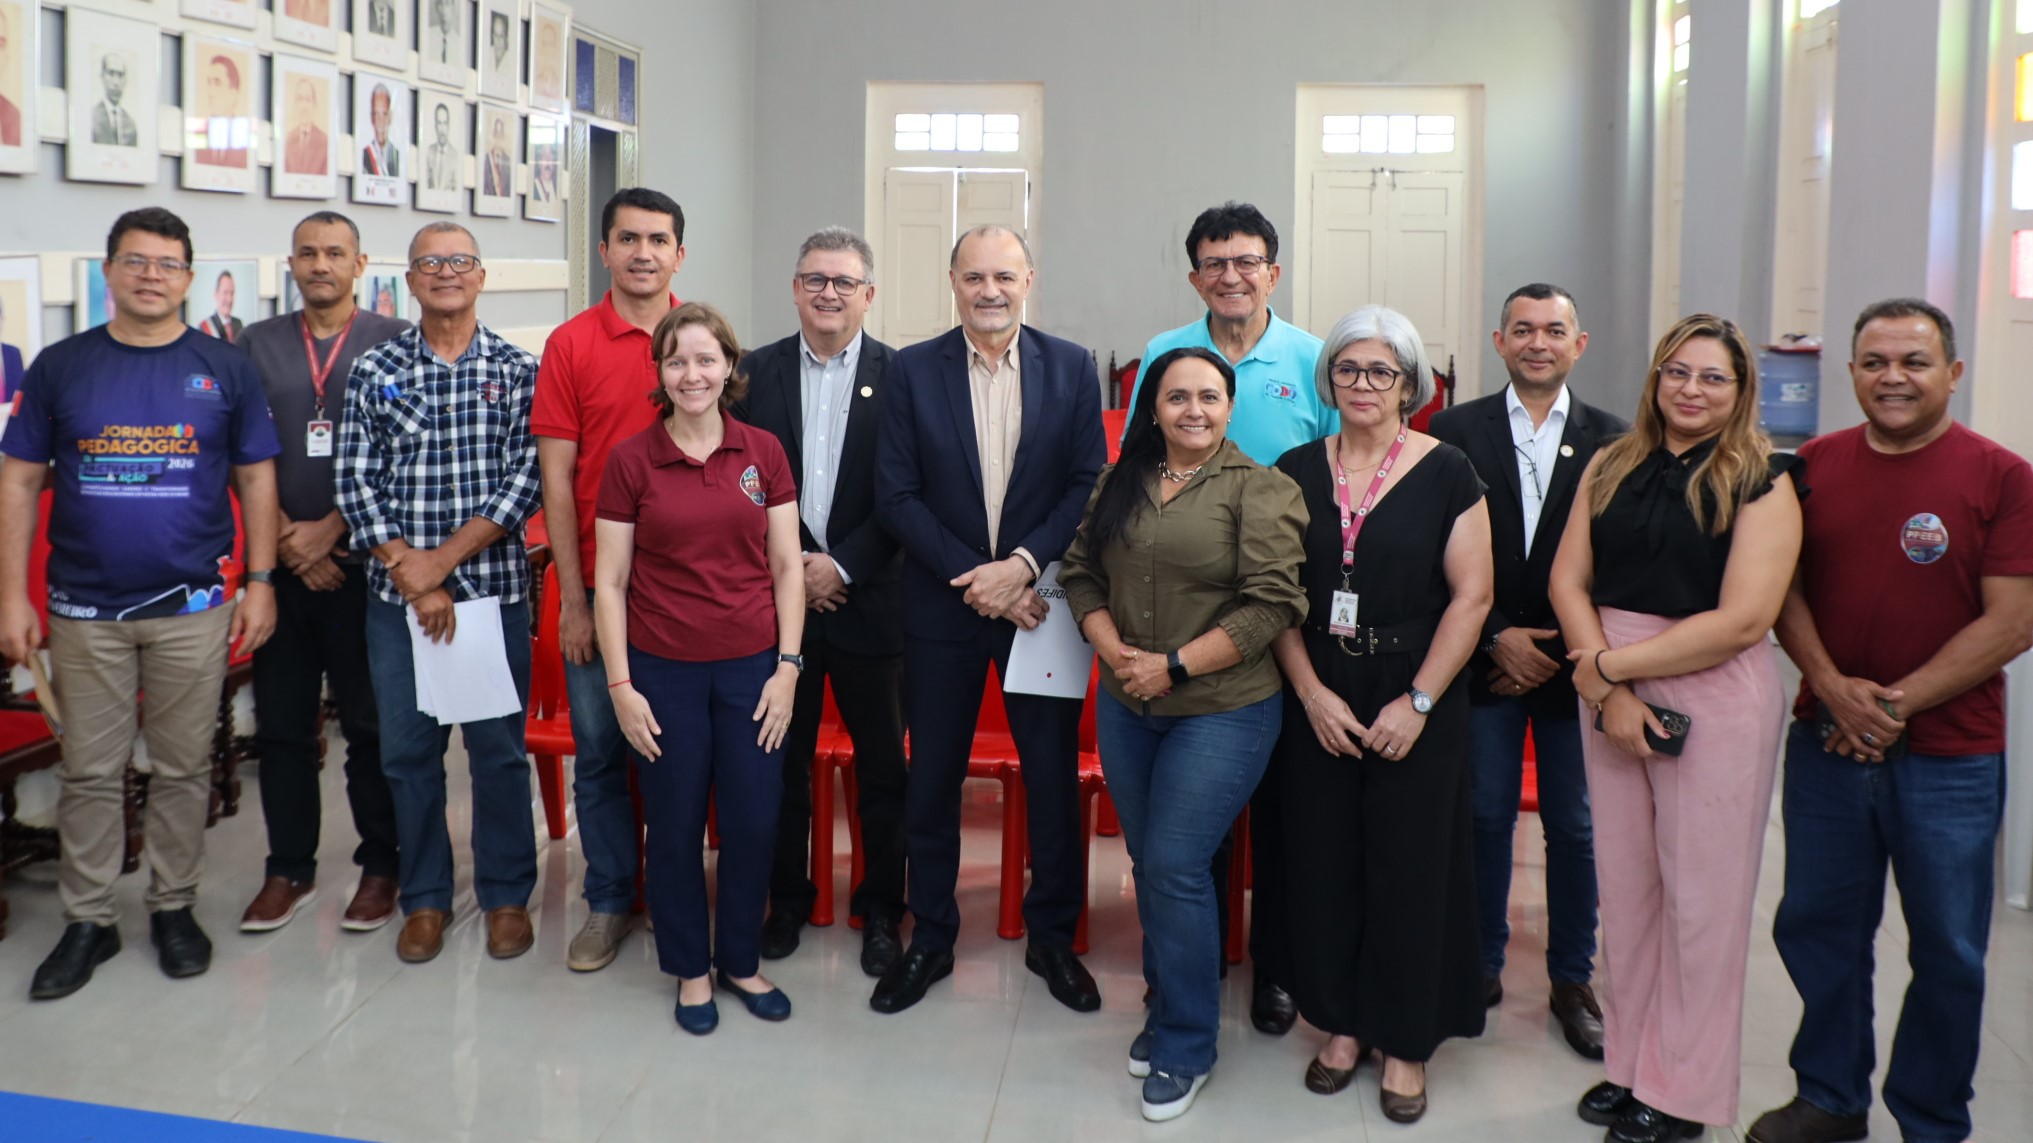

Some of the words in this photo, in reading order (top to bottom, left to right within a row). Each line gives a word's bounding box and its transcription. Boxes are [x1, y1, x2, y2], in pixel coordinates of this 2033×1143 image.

[100, 425, 175, 438] JORNADA
[78, 437, 200, 455] PEDAGÓGICA
[167, 458, 195, 469] 2026
